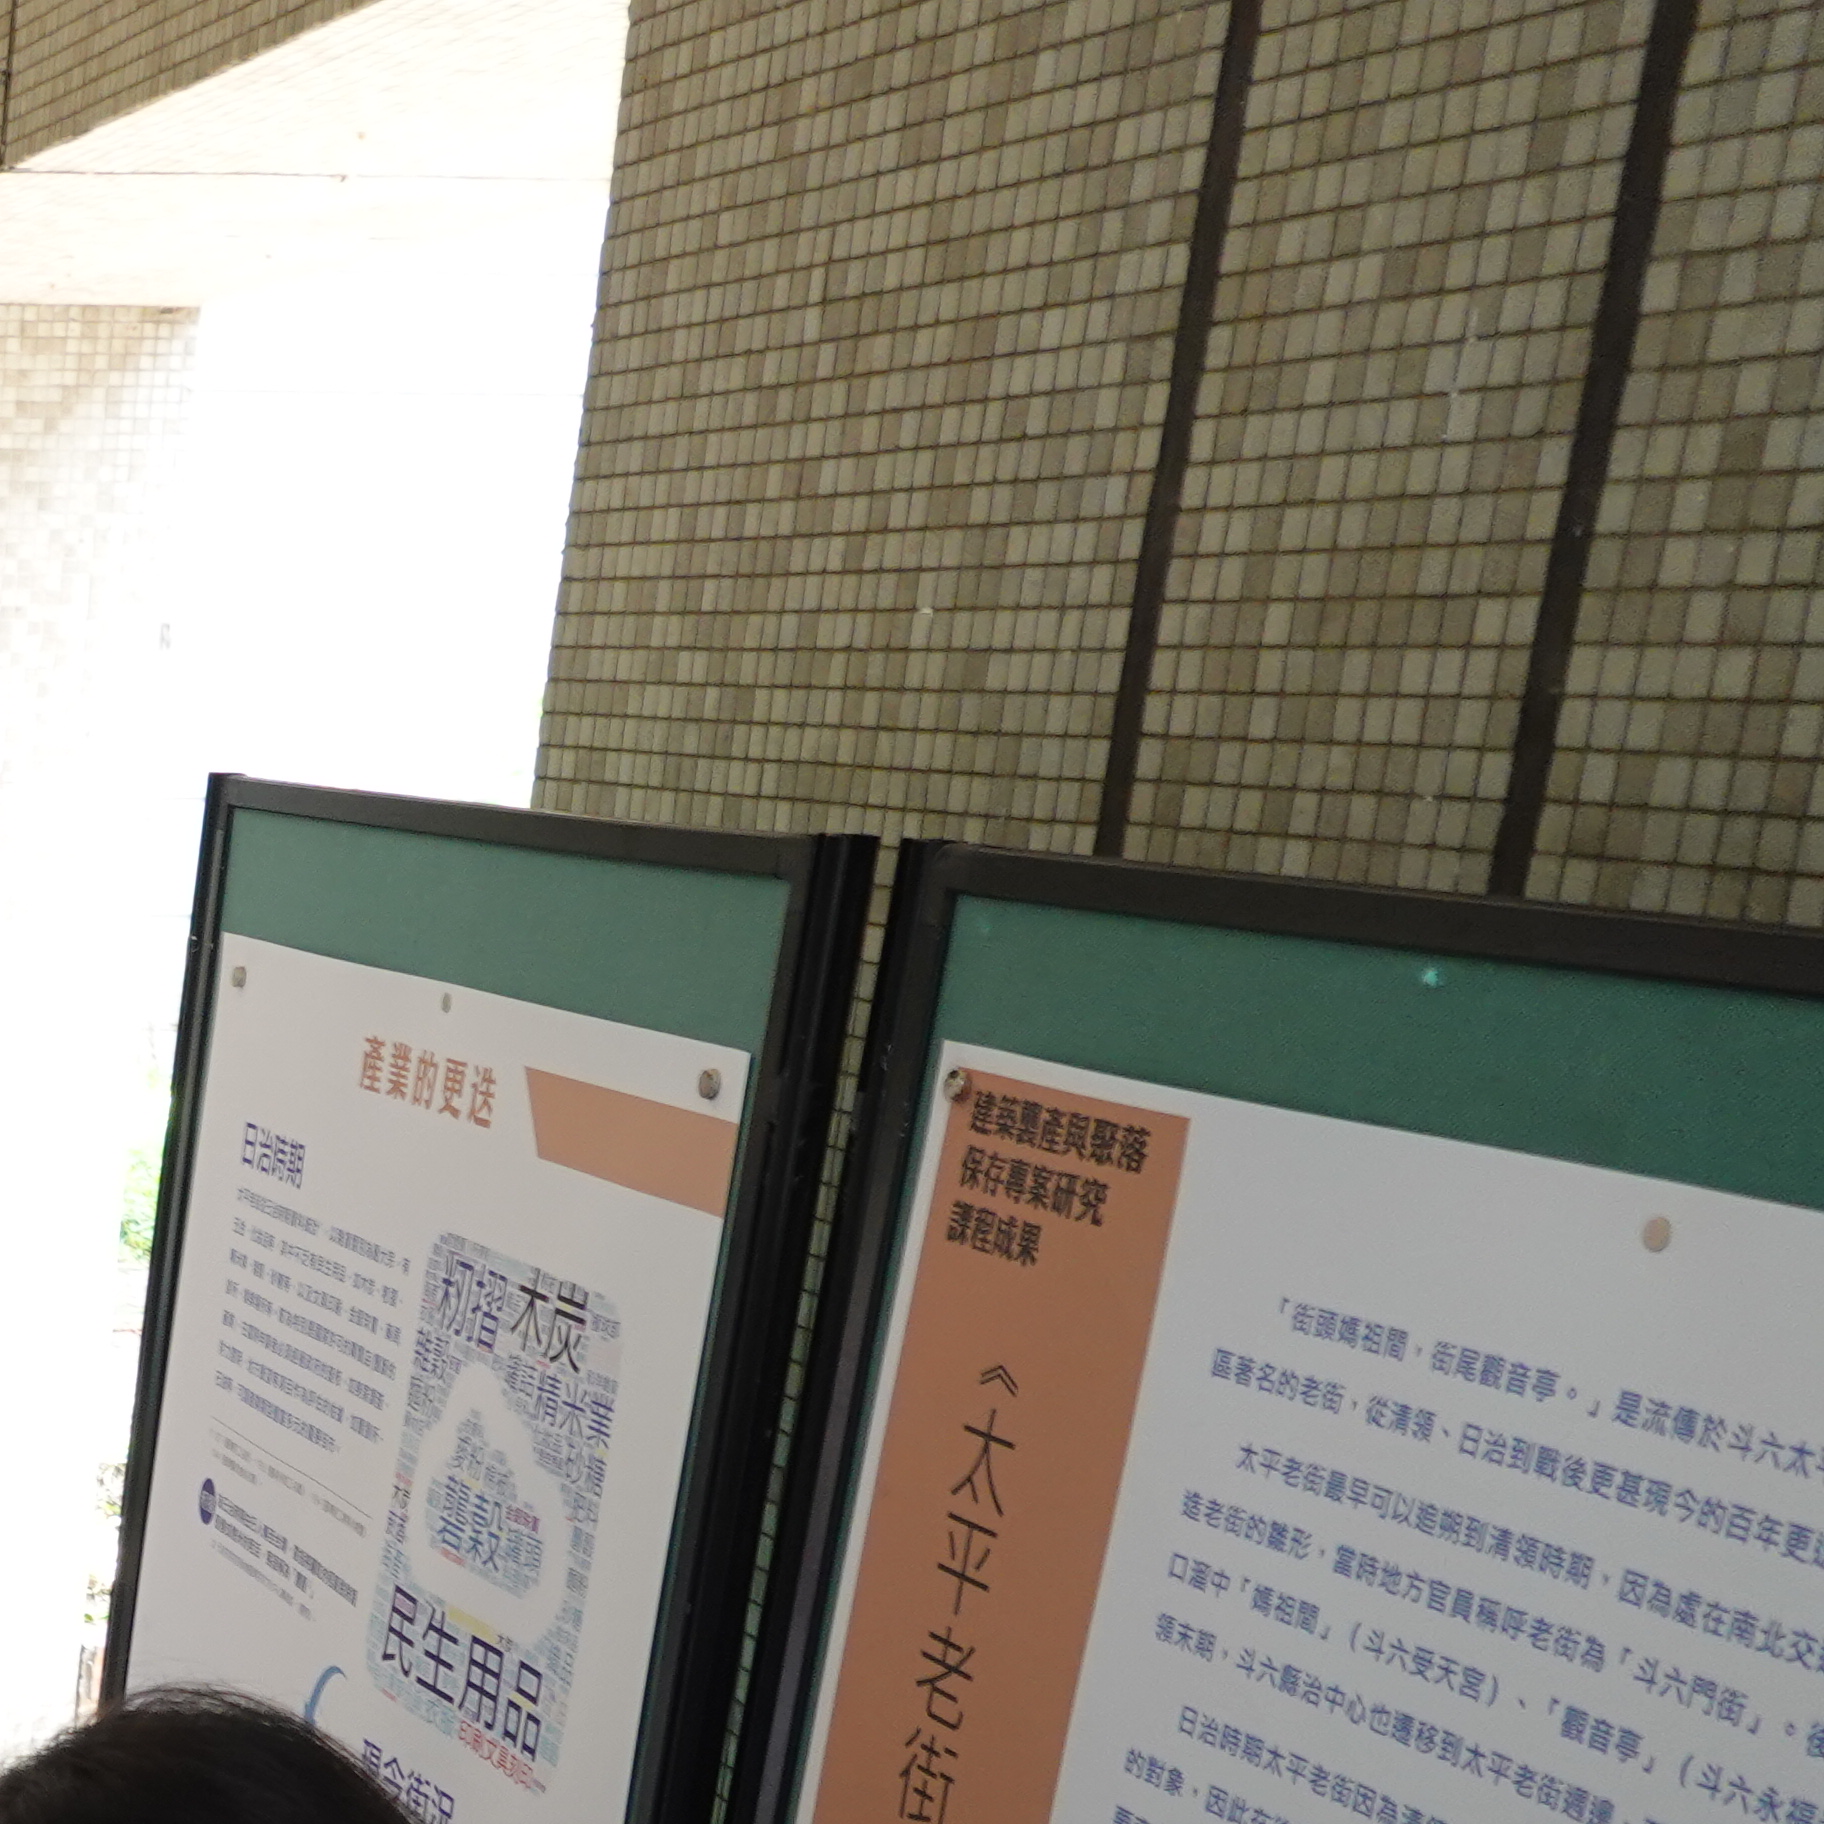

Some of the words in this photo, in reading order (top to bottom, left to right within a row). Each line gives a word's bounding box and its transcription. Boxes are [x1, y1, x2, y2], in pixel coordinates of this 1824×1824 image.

[359, 1035, 498, 1129] 產業的更迭
[239, 1119, 306, 1191] 日治時期
[969, 1090, 1152, 1175] 建築襲產與聚落
[959, 1144, 1111, 1228] 保存專案研究
[946, 1199, 1043, 1268] 課程成果
[509, 1266, 590, 1374] 木炭
[381, 1583, 544, 1763] 民生用品
